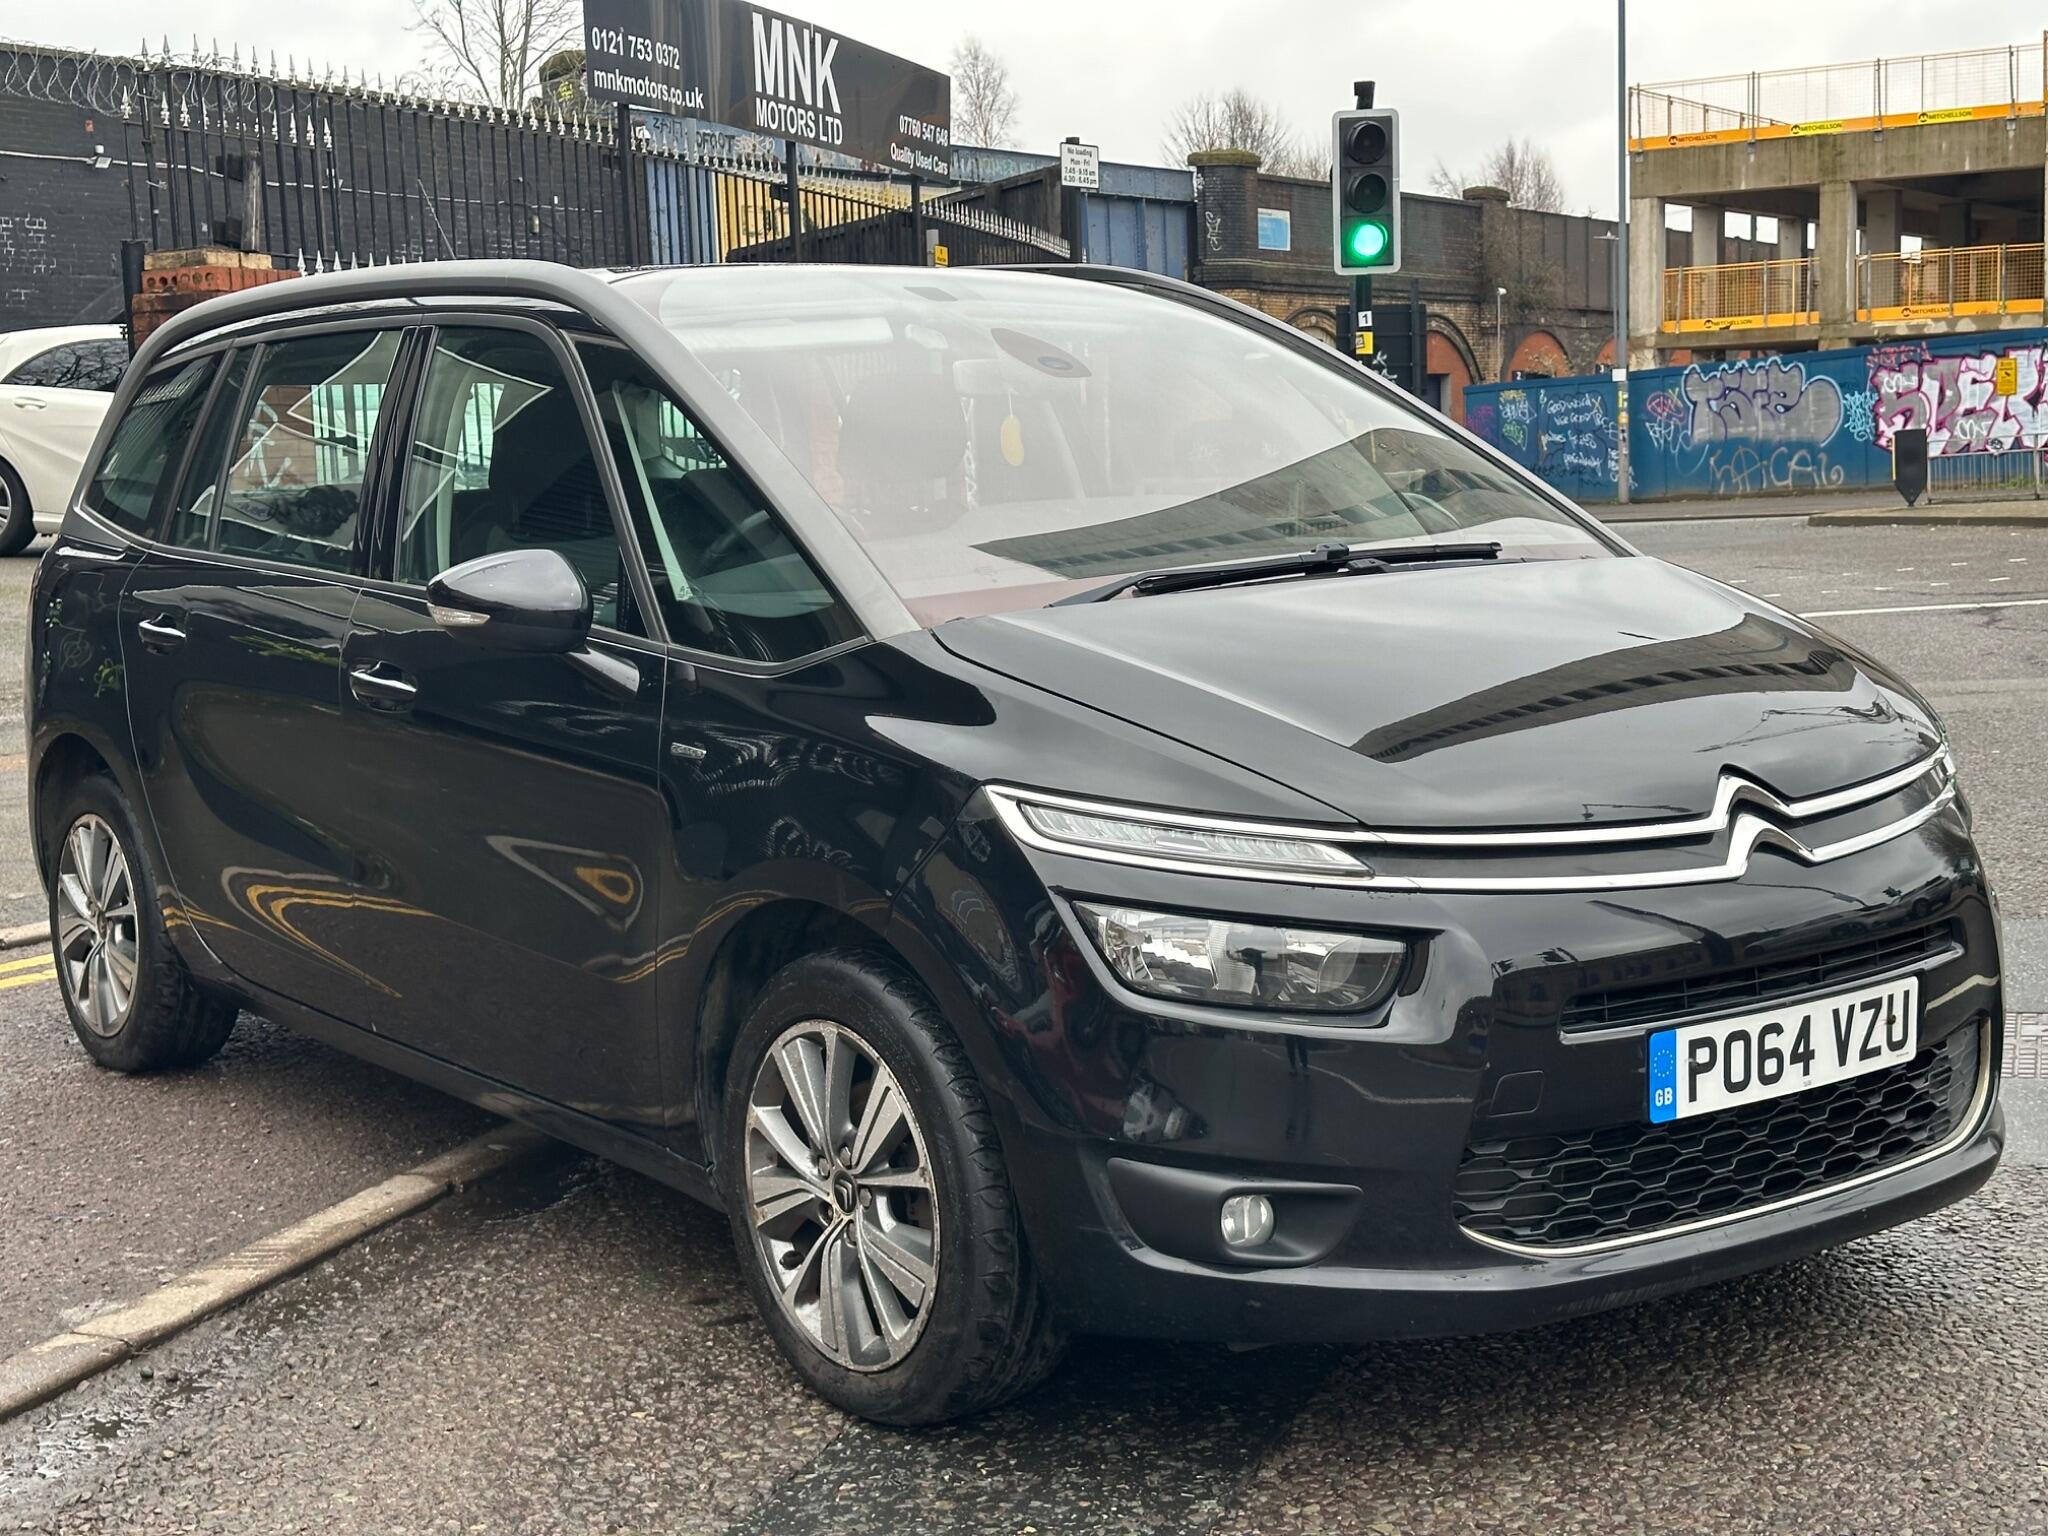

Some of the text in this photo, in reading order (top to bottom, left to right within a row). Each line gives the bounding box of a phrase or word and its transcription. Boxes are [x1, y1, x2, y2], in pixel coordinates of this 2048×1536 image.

[592, 27, 680, 70] 0121 753 0372
[752, 12, 841, 114] MNK
[594, 69, 705, 109] mnkmotors.co.uk
[756, 97, 816, 138] MOTORS
[819, 113, 843, 145] LTD
[922, 122, 936, 142] 547
[891, 142, 915, 169] Quality
[915, 150, 932, 170] Used
[933, 156, 948, 175] Cars
[1075, 148, 1092, 158] loading
[1362, 313, 1368, 324] 1
[1688, 989, 1910, 1103] PO64 VZU
[1655, 1087, 1673, 1106] GB
